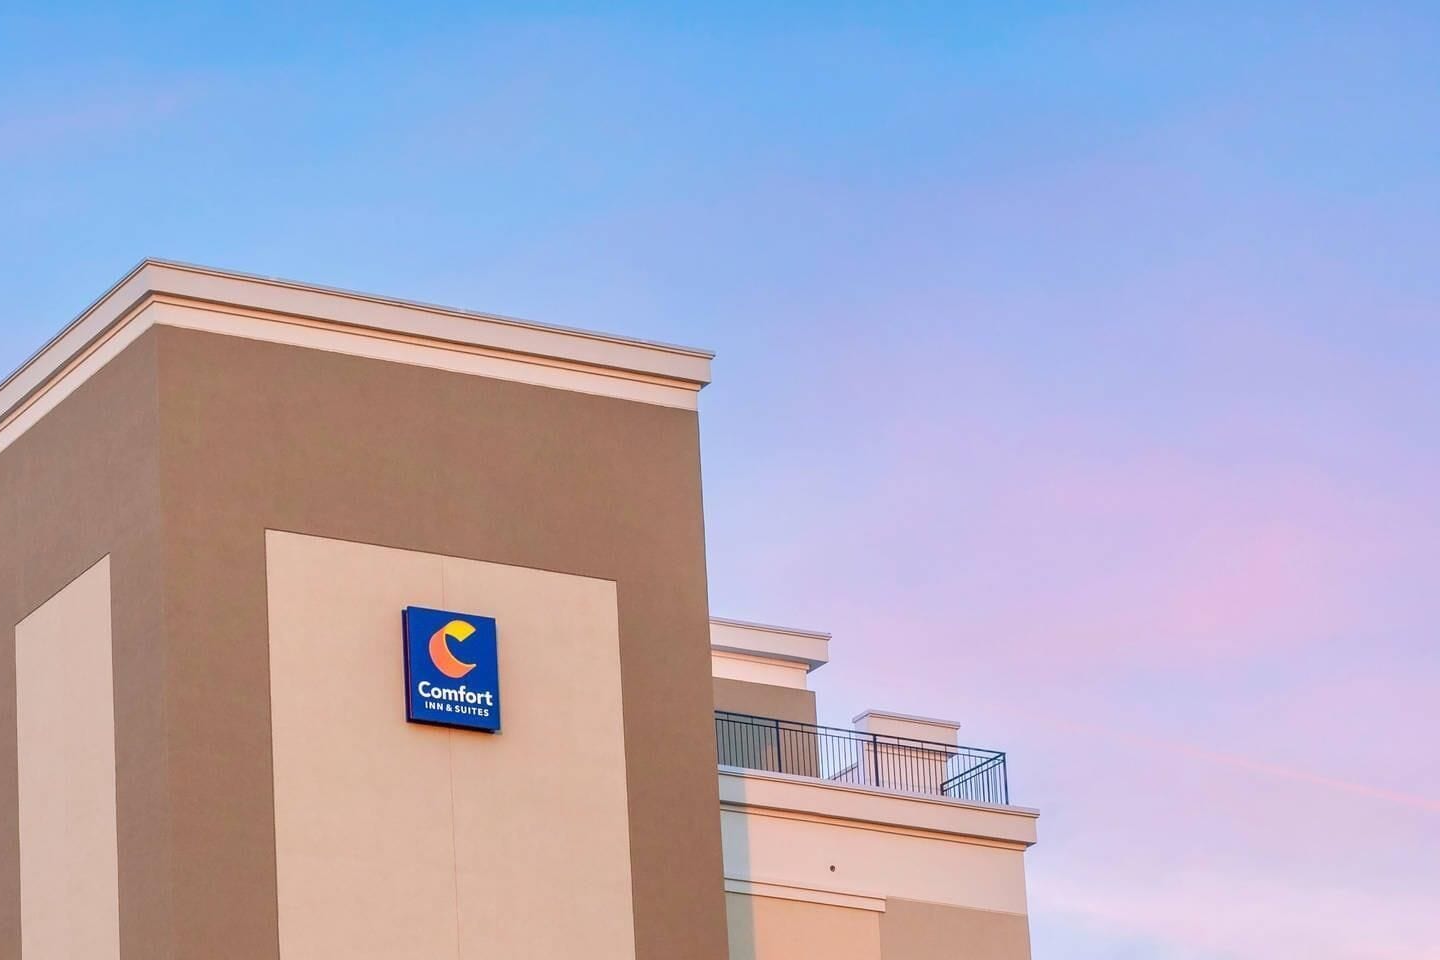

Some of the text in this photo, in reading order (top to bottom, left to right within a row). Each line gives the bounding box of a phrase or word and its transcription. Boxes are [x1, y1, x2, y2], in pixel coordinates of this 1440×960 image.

[418, 681, 493, 706] Comfort
[425, 701, 489, 716] INN & SUITES
